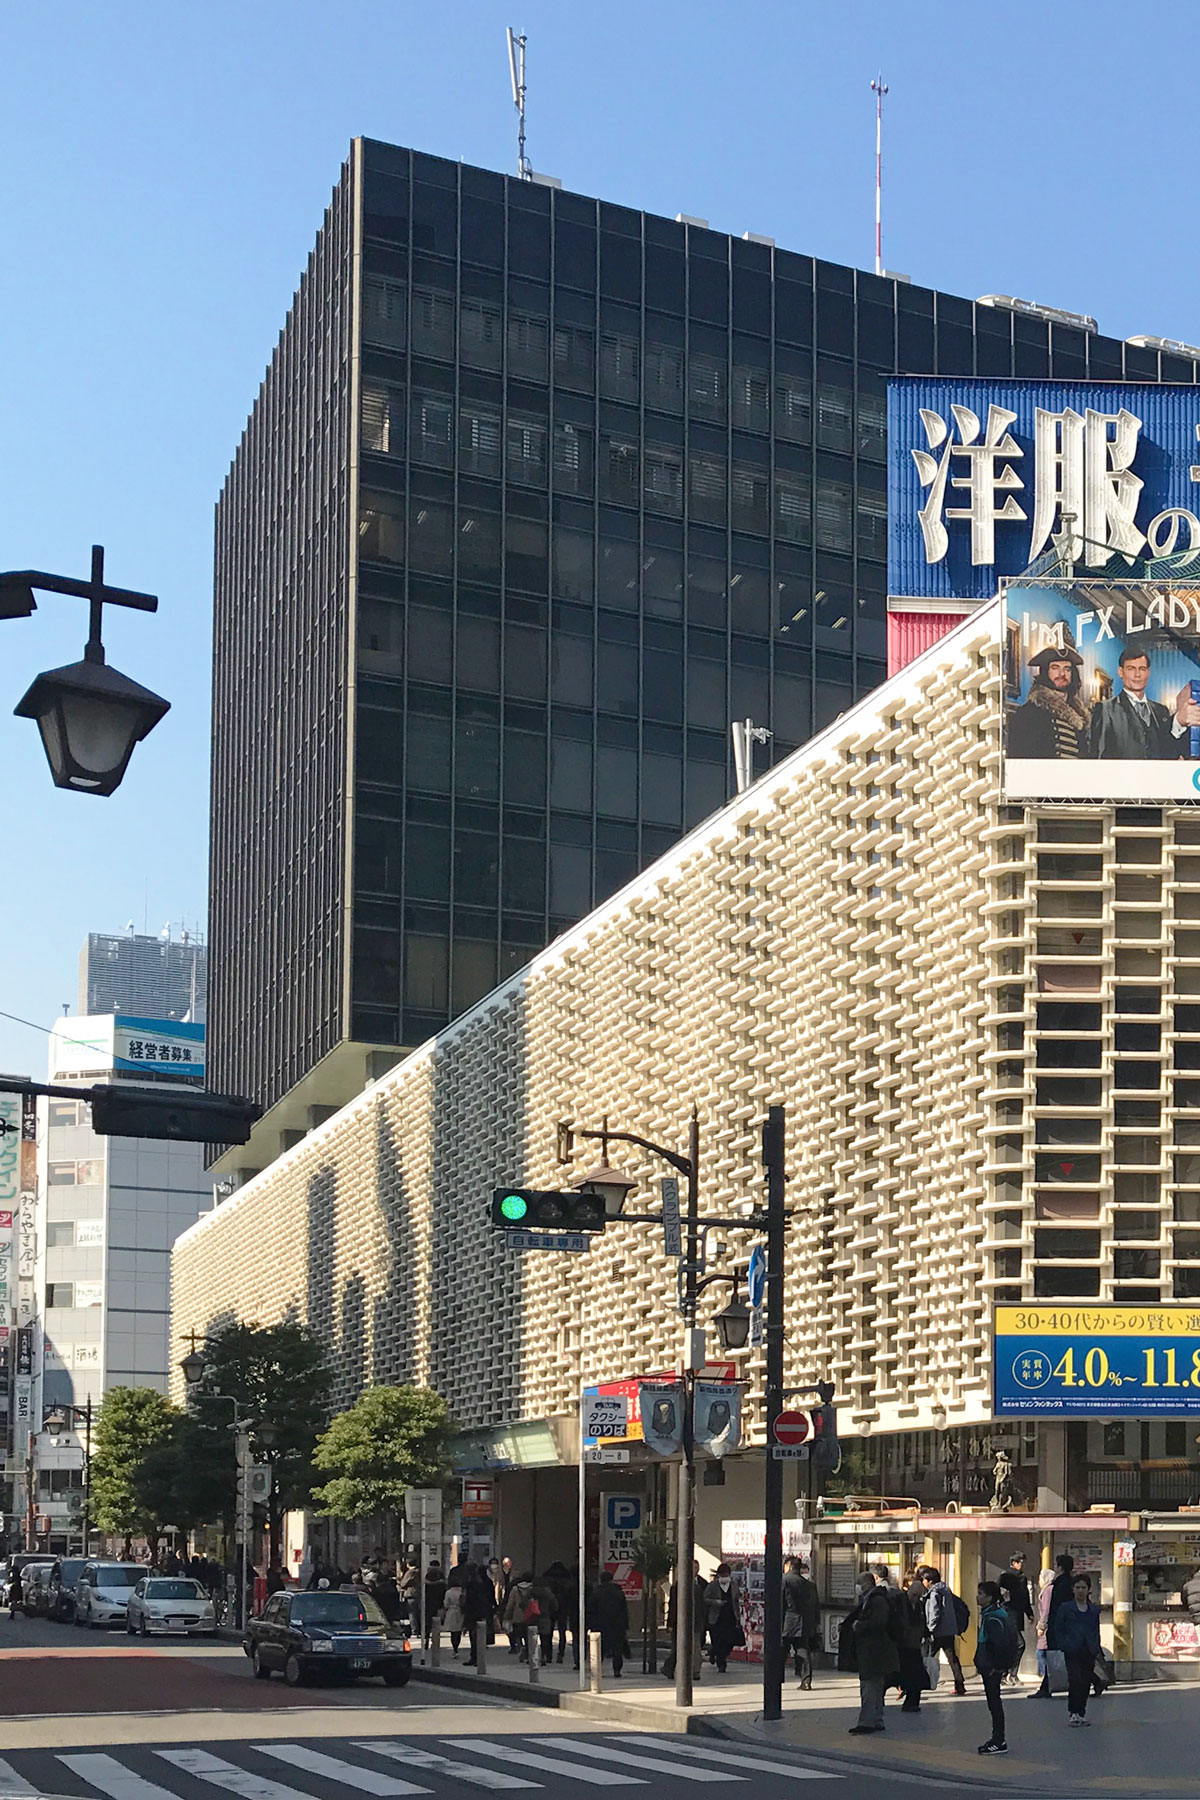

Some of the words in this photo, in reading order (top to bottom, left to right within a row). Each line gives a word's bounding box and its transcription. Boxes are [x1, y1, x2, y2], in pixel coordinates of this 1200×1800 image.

[1076, 605, 1116, 648] FX
[128, 1040, 192, 1062] 経営者募集
[513, 1235, 584, 1249] 自転車専用
[18, 1397, 28, 1417] BAR
[589, 1412, 627, 1422] タクシー
[590, 1424, 626, 1436] のりば
[614, 1501, 636, 1525] P
[614, 1530, 633, 1539] 有料
[734, 1531, 767, 1546] OPENIN
[609, 1540, 633, 1549] 駐車
[608, 1551, 630, 1560] 入口
